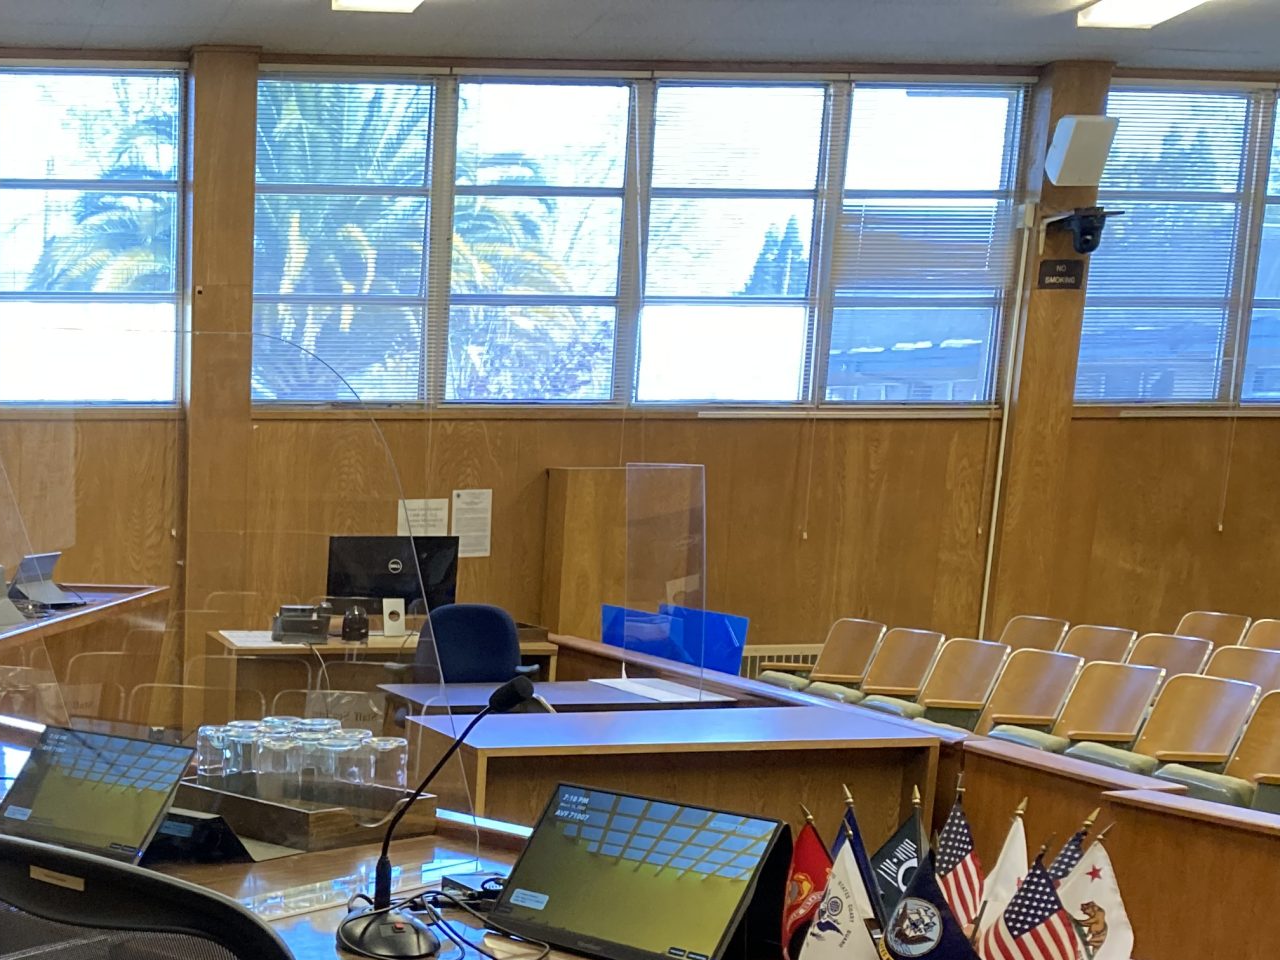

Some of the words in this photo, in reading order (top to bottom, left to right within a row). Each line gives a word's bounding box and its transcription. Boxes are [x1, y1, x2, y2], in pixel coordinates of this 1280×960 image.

[1056, 264, 1067, 272] NO
[1044, 275, 1076, 284] SMOKING
[577, 796, 590, 804] PM
